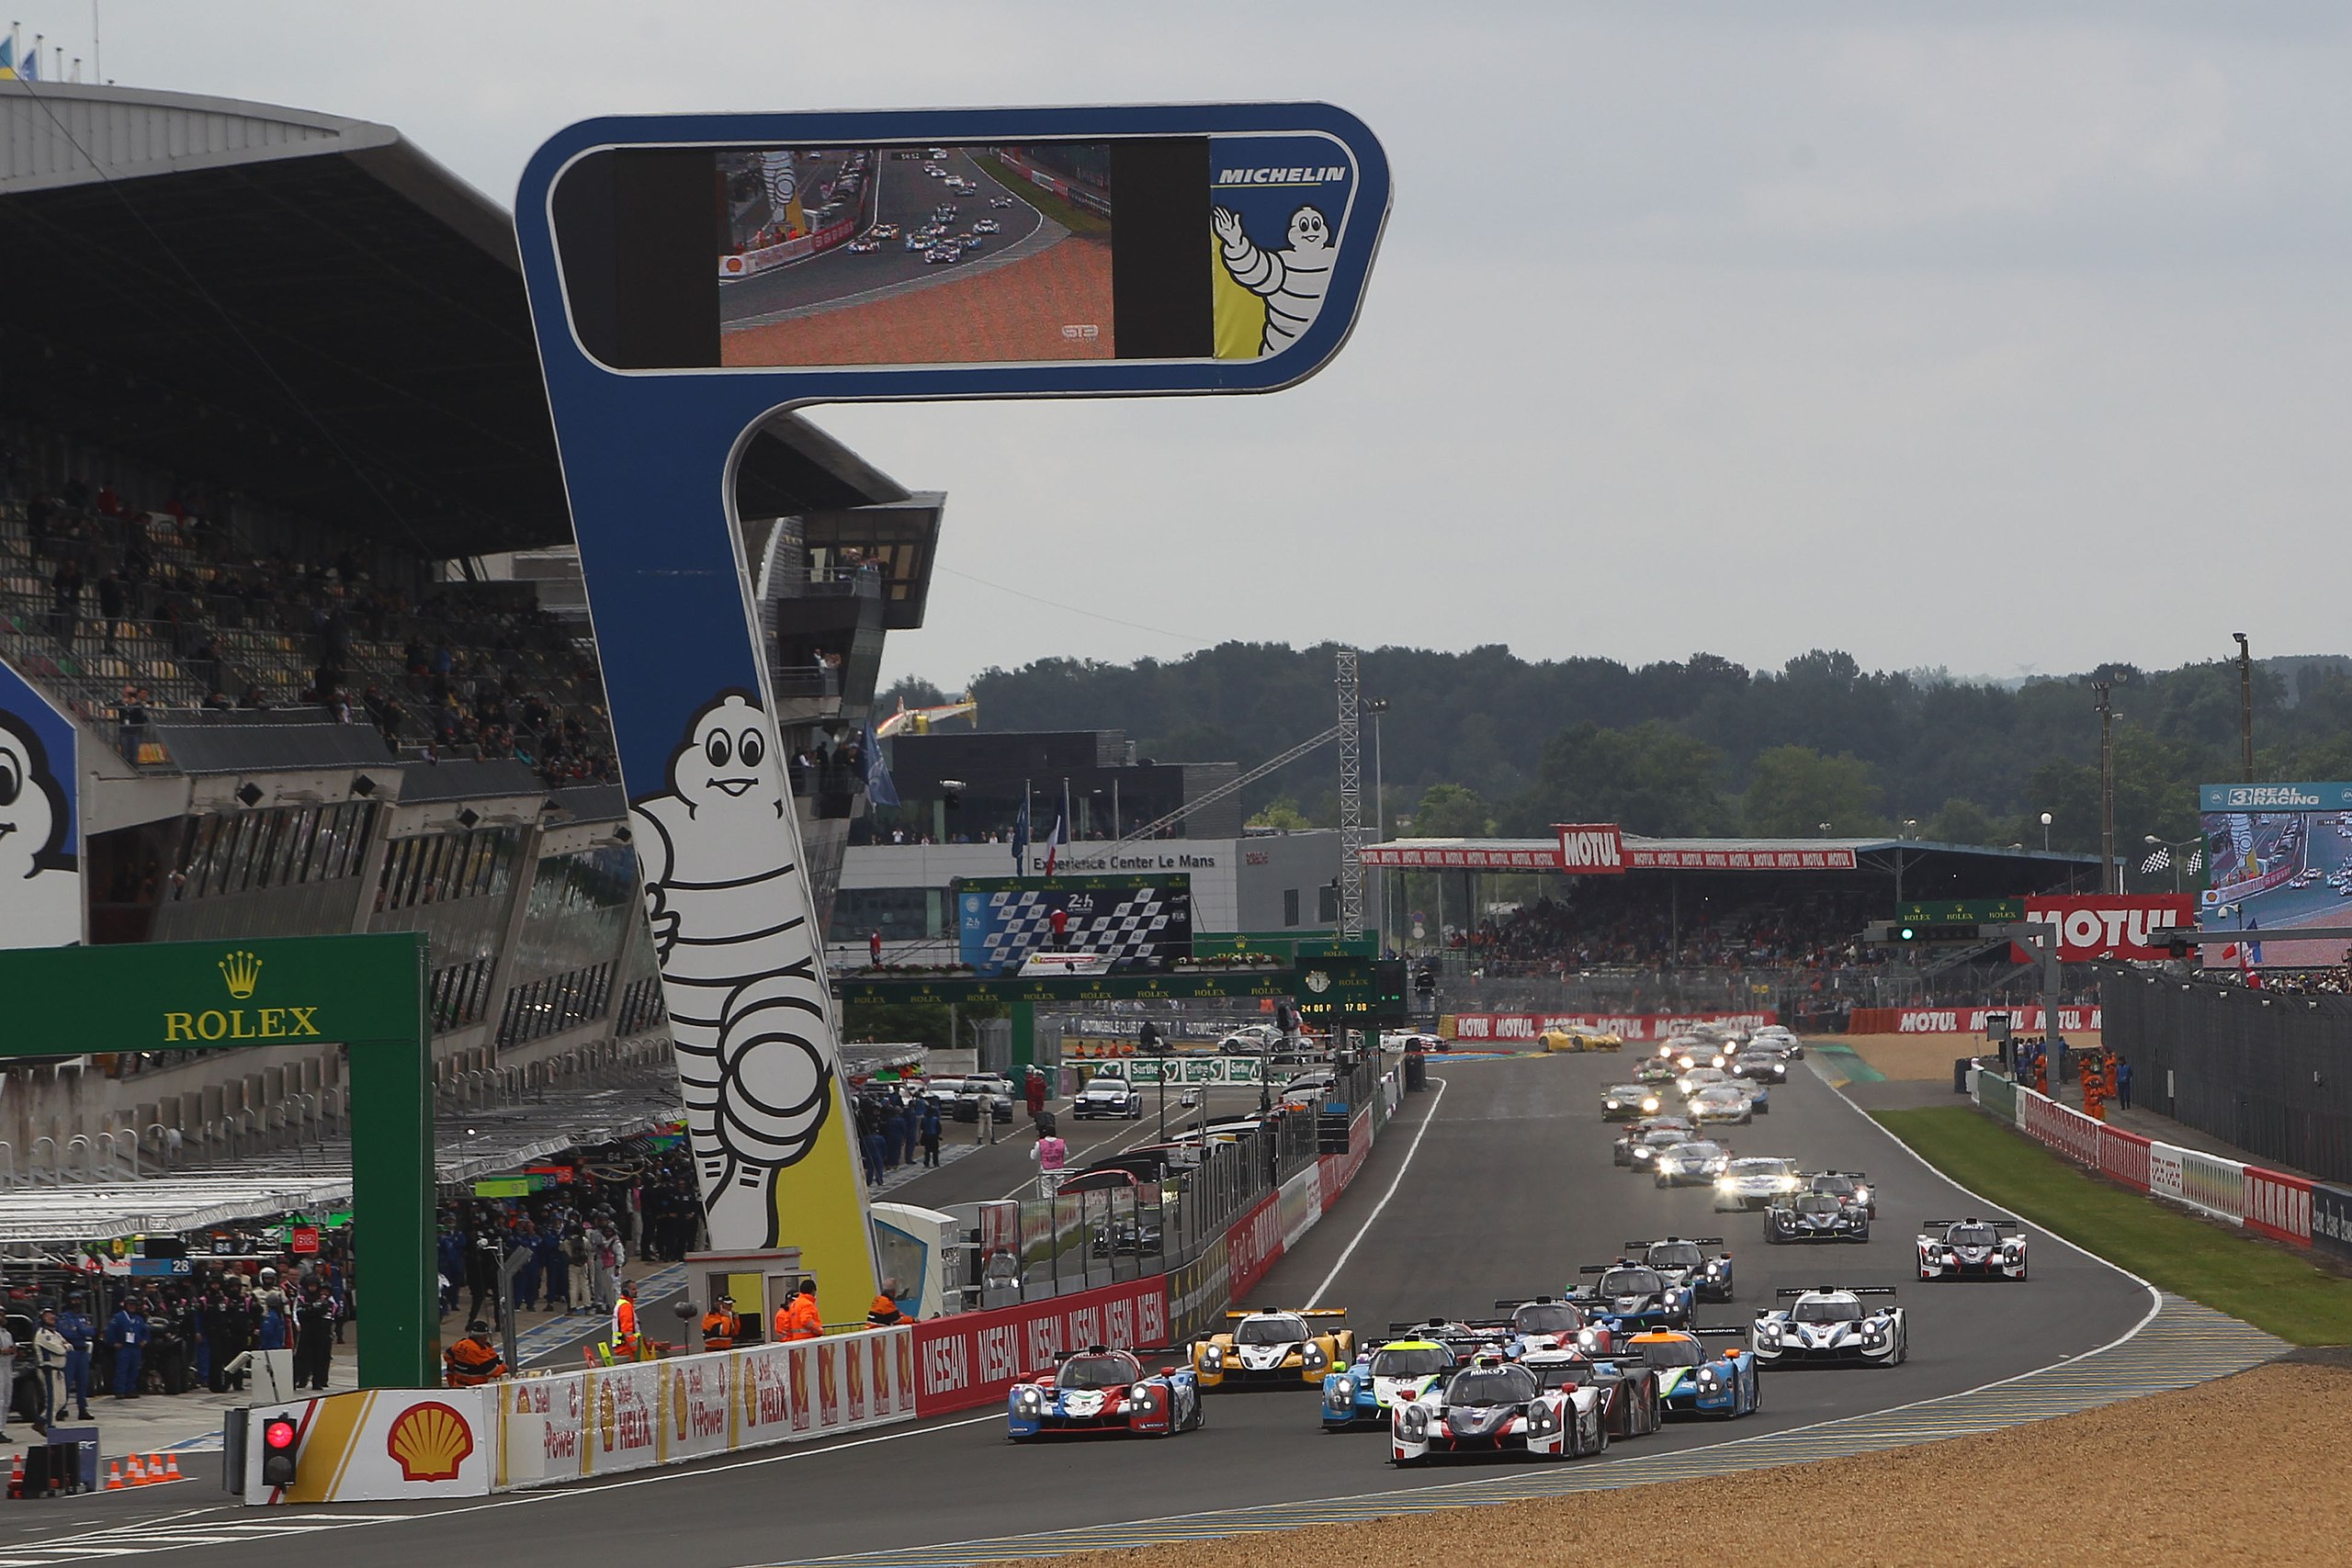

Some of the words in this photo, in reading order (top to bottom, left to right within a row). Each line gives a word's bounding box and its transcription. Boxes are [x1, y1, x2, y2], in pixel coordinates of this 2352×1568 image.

[1218, 166, 1346, 184] MICHELIN
[2254, 787, 2301, 796] REAL
[2254, 795, 2319, 806] RACING
[1564, 832, 1620, 866] MOTUL
[1034, 857, 1105, 873] Experience
[1111, 856, 1153, 870] Center
[1159, 856, 1175, 868] Le
[1180, 855, 1215, 867] Mans
[1381, 852, 1400, 863] MOTUL
[1402, 852, 1421, 863] MOTUL
[1424, 852, 1443, 864] MOTUL
[1445, 852, 1464, 864] MOTUL
[1467, 852, 1487, 864] MOTUL
[1489, 852, 1510, 865] MOTUL
[1511, 852, 1532, 865] MOTUL
[1533, 853, 1555, 866] MOTUL
[1634, 852, 1655, 865] MOTUL
[1657, 852, 1679, 866] MOTUL
[1681, 853, 1702, 866] MOTUL
[1705, 853, 1726, 866] MOTUL
[1729, 853, 1750, 866] MOTUL
[1753, 853, 1775, 867] MOTUL
[1778, 852, 1800, 866] MOTUL
[1802, 852, 1825, 866] MOTUL
[1827, 852, 1850, 865] MOTUL
[1080, 991, 1112, 999] ROLEX
[1137, 990, 1170, 998] ROLEX
[1194, 988, 1226, 997] ROLEX
[1250, 987, 1283, 996] ROLEX
[164, 1007, 322, 1042] ROLEX
[1458, 1018, 1488, 1037] MOTUL
[1496, 1018, 1535, 1038] MOTUL
[1899, 1011, 1958, 1032] MOTUL
[2033, 1010, 2081, 1030] MTUL
[1132, 1062, 1159, 1075] Sarthe
[1186, 1062, 1208, 1075] Sarthe
[1230, 1061, 1250, 1074] Sarthe
[607, 1152, 621, 1162] 64
[173, 1259, 189, 1272] 28
[1105, 1298, 1134, 1349] NISSAN
[1137, 1291, 1164, 1344] NISSAN
[1069, 1306, 1100, 1351] NISSAN
[1028, 1315, 1063, 1371] NISSAN
[978, 1324, 1020, 1384] NISSAN
[923, 1334, 967, 1395] NISSAN
[760, 1371, 788, 1425] HELIX
[619, 1392, 652, 1450] HELIX
[690, 1401, 724, 1438] V-Power
[544, 1420, 575, 1460] -Power
